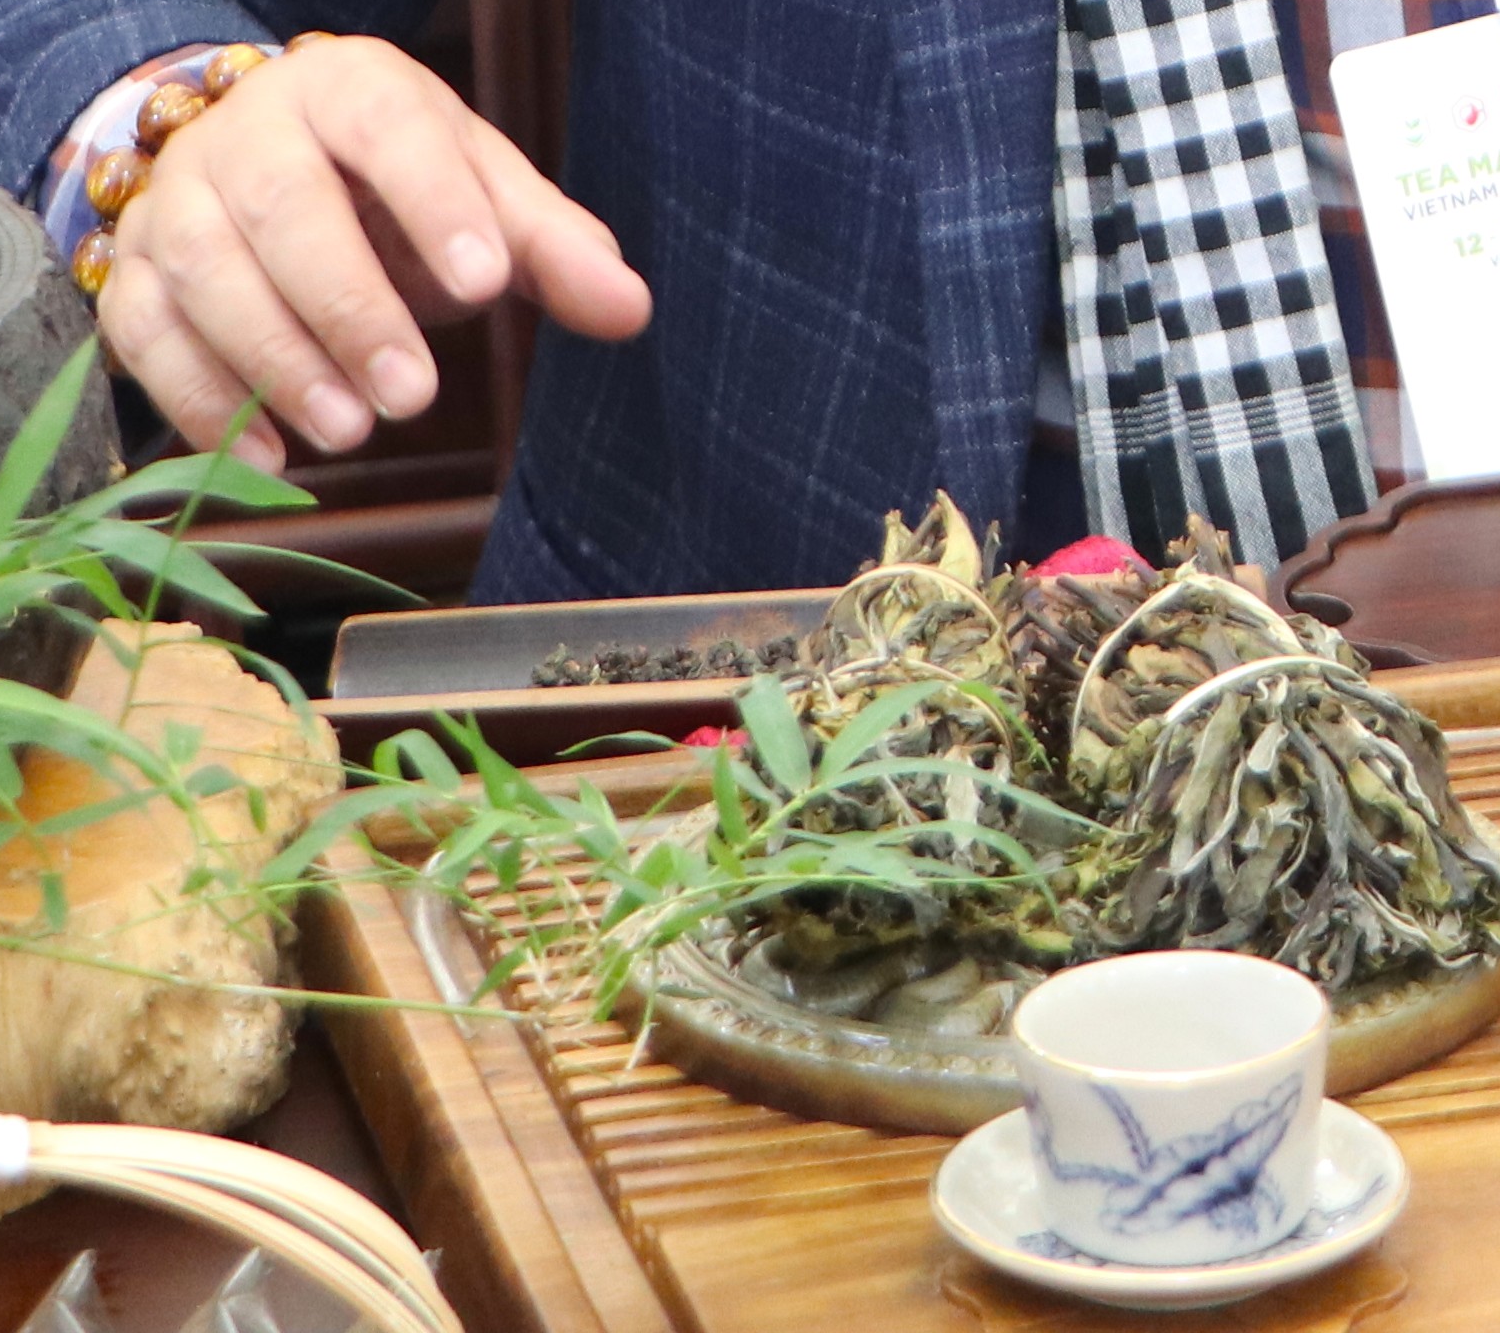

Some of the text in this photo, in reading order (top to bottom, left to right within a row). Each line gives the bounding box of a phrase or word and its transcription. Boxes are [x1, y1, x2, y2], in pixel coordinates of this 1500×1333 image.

[1396, 164, 1460, 197] TEA
[1403, 183, 1498, 221] VIETNAM
[1453, 232, 1484, 258] 12
